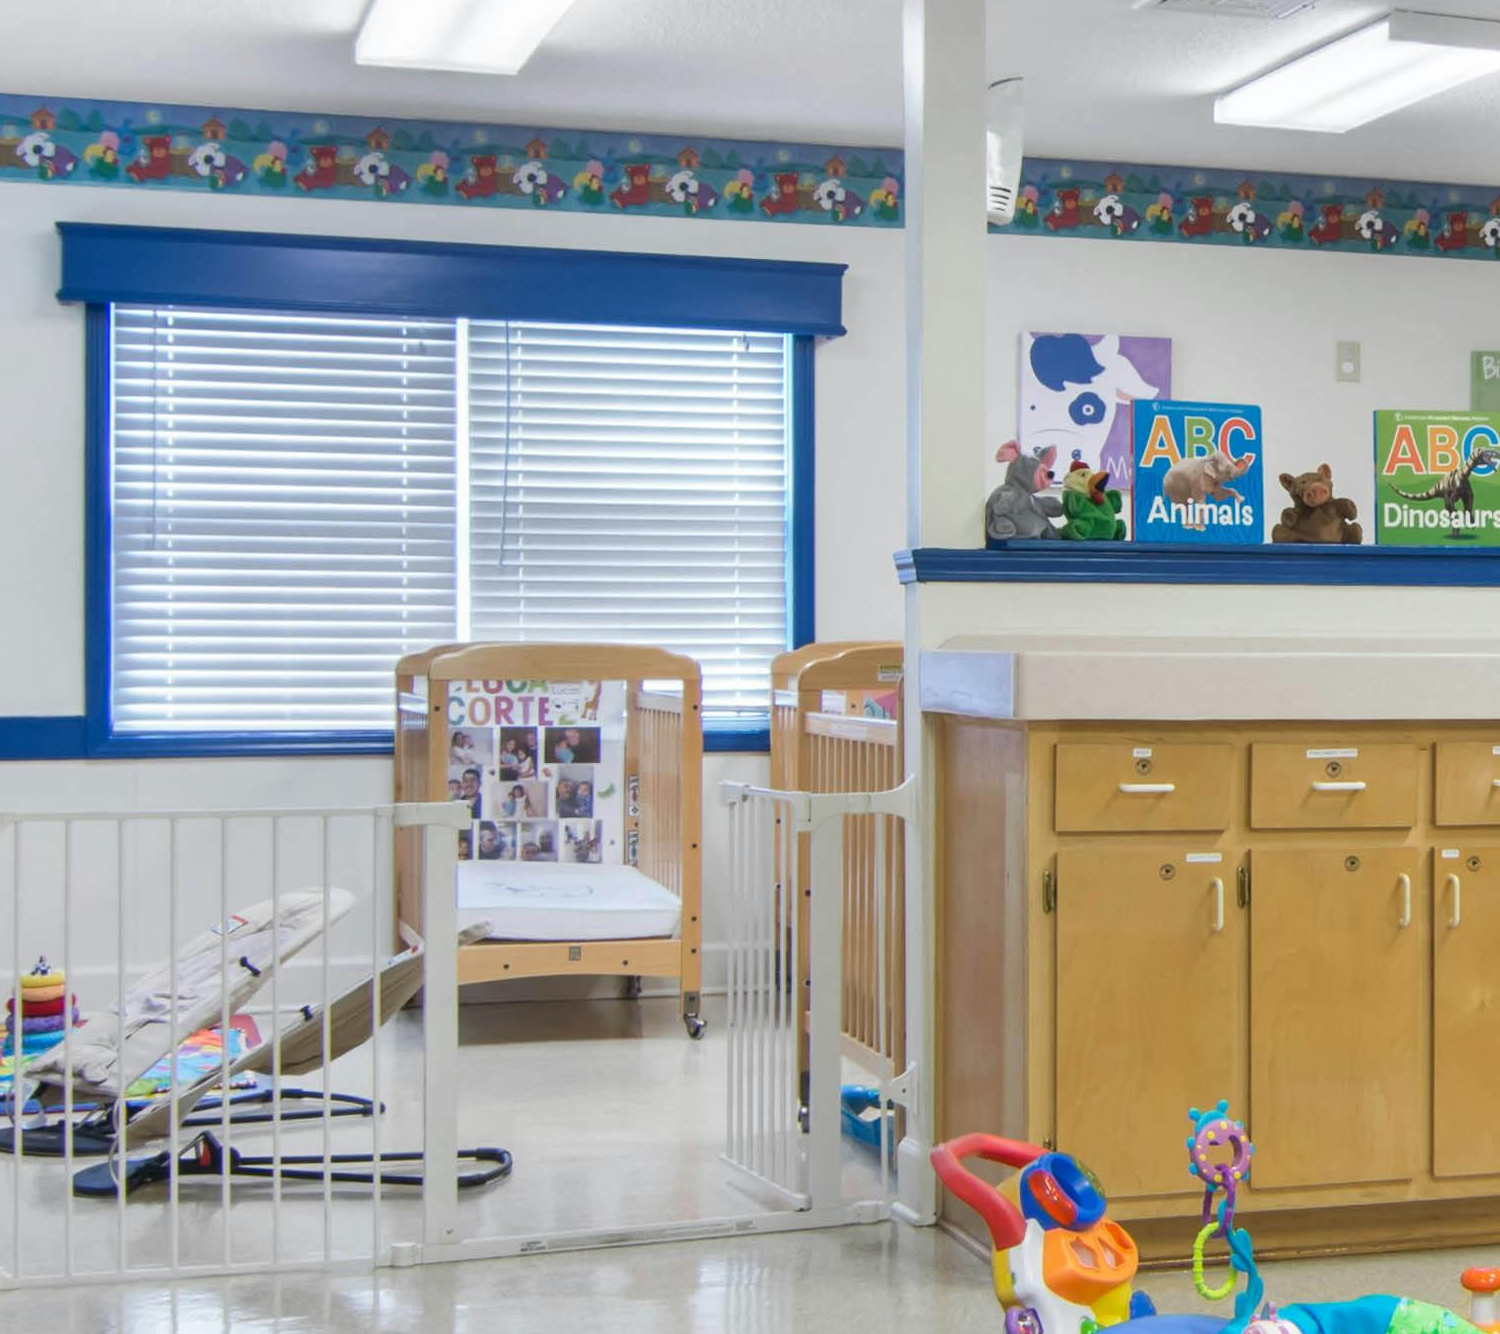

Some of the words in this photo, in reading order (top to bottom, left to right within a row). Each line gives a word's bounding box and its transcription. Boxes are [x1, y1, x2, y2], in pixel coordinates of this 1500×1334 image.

[1139, 415, 1256, 469] ABC
[1382, 424, 1500, 477] ABC
[1147, 495, 1254, 527] Animals
